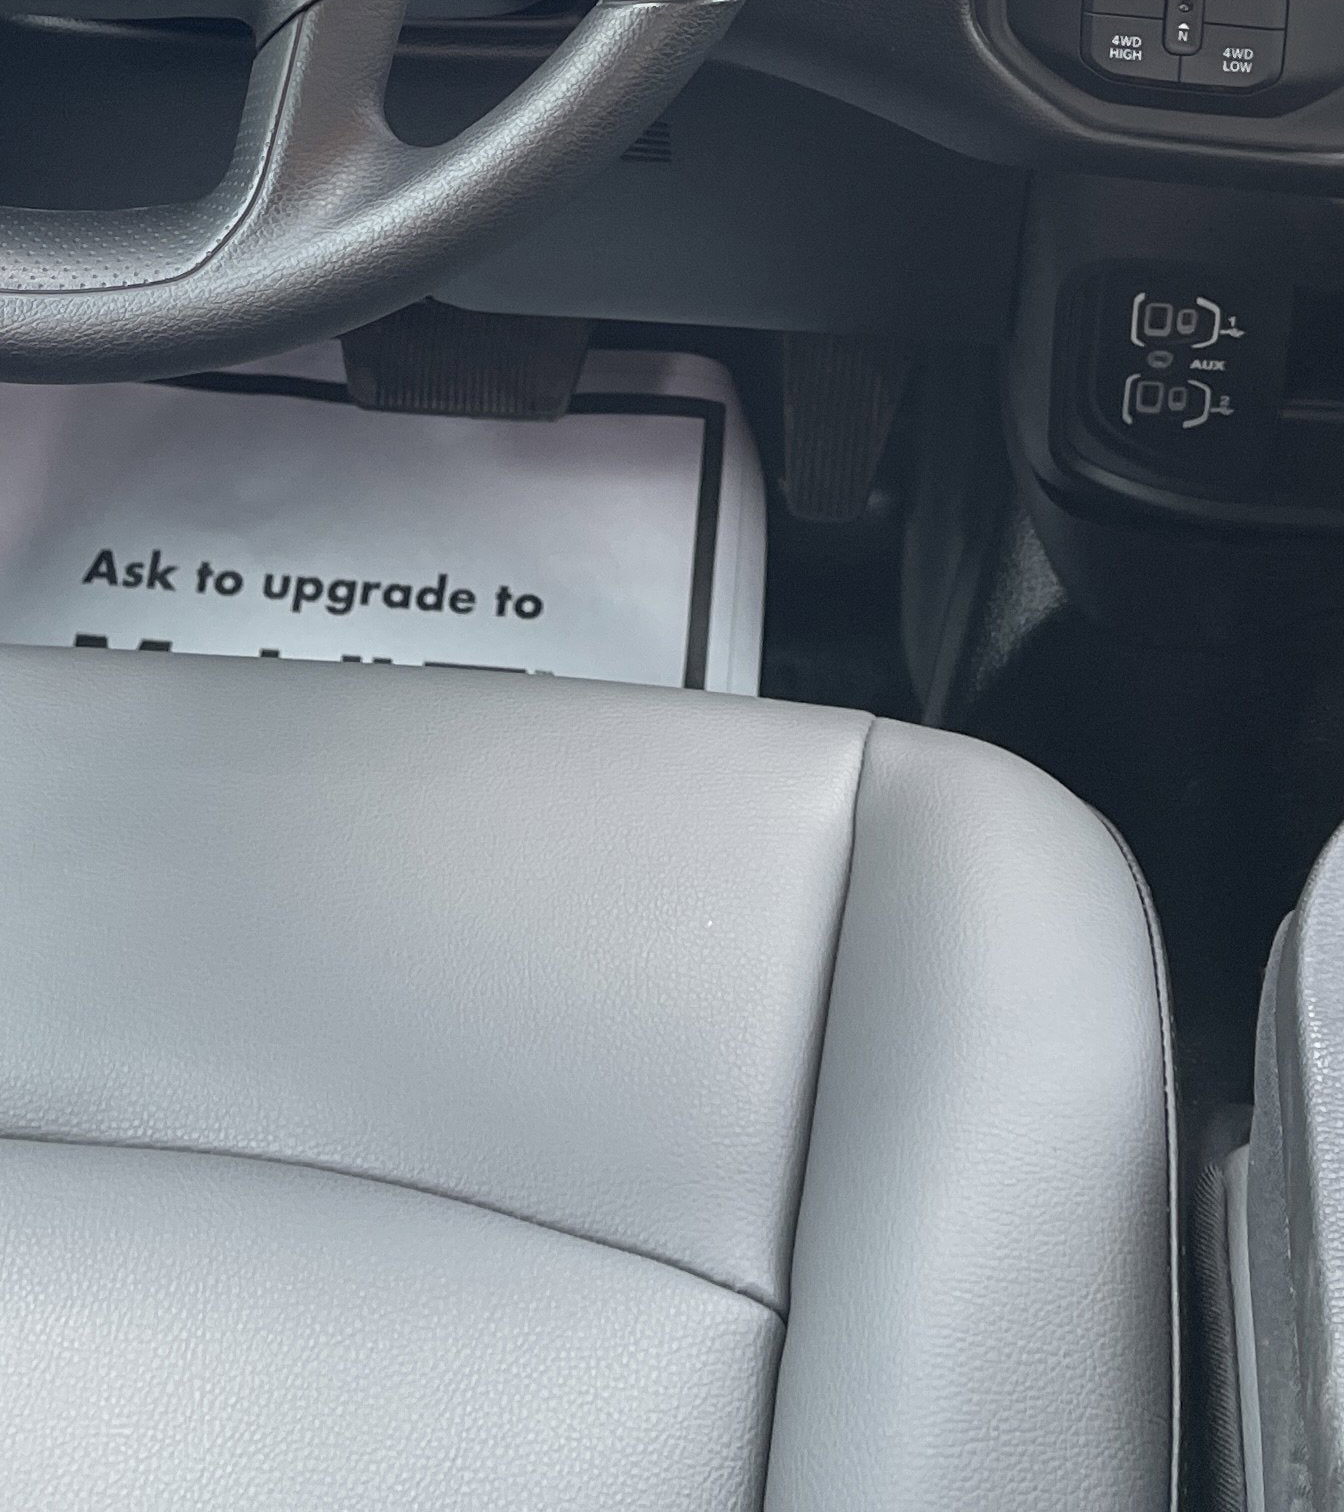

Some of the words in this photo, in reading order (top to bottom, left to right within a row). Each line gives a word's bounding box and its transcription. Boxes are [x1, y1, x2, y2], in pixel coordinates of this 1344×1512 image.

[1111, 35, 1143, 48] 4WD
[1177, 30, 1189, 43] N
[1109, 48, 1143, 61] HIGH
[1222, 47, 1255, 60] 4WD
[1222, 60, 1253, 73] LOW
[1189, 359, 1226, 371] AUX
[82, 548, 179, 592] Ask
[195, 559, 244, 598] to
[262, 570, 477, 619] upgrade
[493, 585, 544, 620] to
